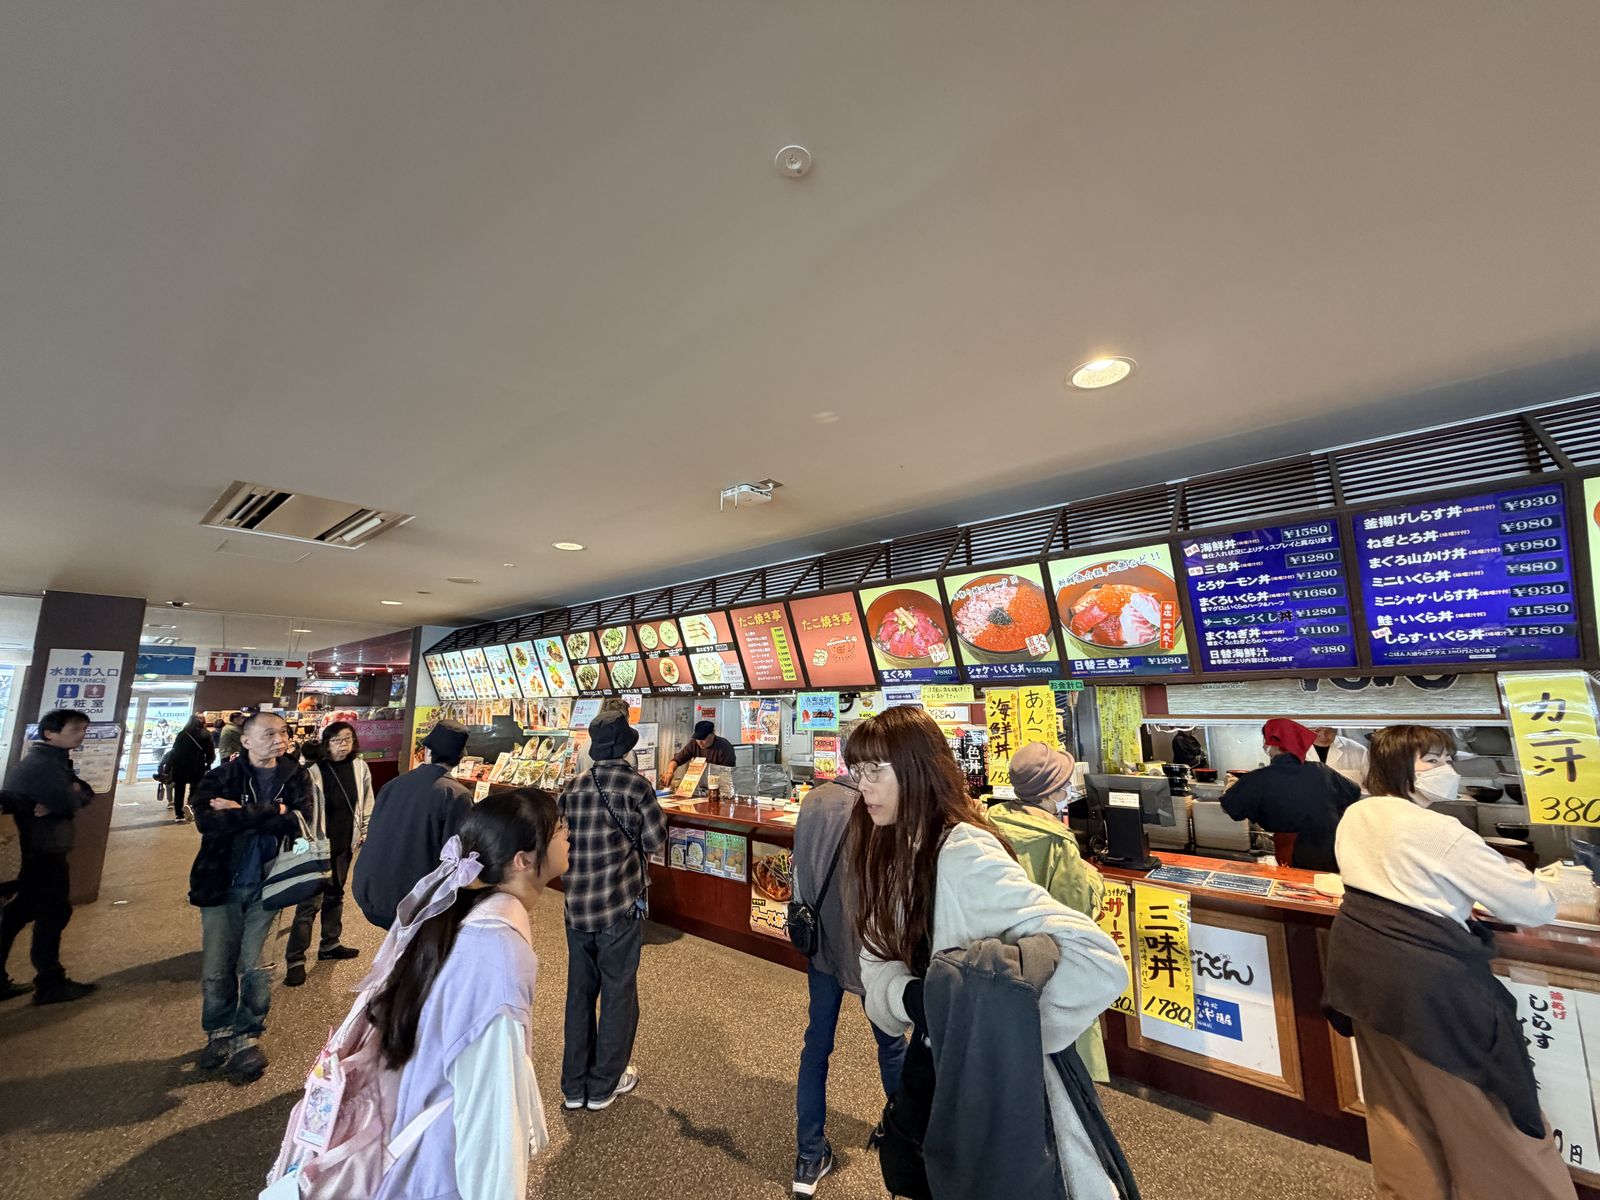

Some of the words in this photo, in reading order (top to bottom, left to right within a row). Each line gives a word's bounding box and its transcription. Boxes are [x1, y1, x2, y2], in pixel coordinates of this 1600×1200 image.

[1364, 505, 1463, 529] 釜揚げしらす丼
[1505, 495, 1557, 510] ¥930
[1200, 540, 1236, 552] 海鮮丼
[1284, 525, 1328, 540] ¥1580
[1367, 531, 1438, 549] ねぎとろ丼
[1502, 518, 1553, 533] ¥980
[1369, 548, 1467, 569] まぐろ山かけ丼
[1505, 538, 1557, 552] ¥980
[1204, 561, 1240, 574] 三色丼
[1290, 553, 1334, 566] ¥1280
[1197, 574, 1270, 592] とろサーモン丼
[1296, 569, 1338, 580] ¥1200
[1372, 571, 1451, 587] ミニいくら丼
[1507, 561, 1557, 574] ¥880
[1199, 591, 1268, 607] まぐろいくら丼
[1292, 588, 1337, 599] ¥1680
[1375, 588, 1479, 606] ミニシャケ・しらす丼
[1512, 584, 1564, 597] ¥930
[738, 610, 782, 628] たこ焼き亭
[1297, 606, 1336, 617] ¥1280
[1377, 611, 1454, 626] 鮭・いくら丼
[1510, 604, 1569, 616] ¥1580
[801, 612, 853, 631] たこ焼き亭
[1205, 628, 1261, 642] まぐねぎ丼
[1299, 625, 1339, 636] ¥1100
[1385, 629, 1485, 645] しらす・いくら丼
[1508, 626, 1564, 637] ¥1580
[1311, 645, 1345, 655] ¥380
[251, 657, 283, 666] 化粧室
[968, 664, 1026, 675] シャケ・いくら丼
[1027, 666, 1053, 674] ¥1580
[1074, 658, 1131, 670] 日替三色丼
[50, 667, 118, 678] 水族館入口
[882, 670, 912, 679] まぐろ丼
[1050, 681, 1082, 689] お会計口
[54, 699, 104, 708] 化粧室
[989, 698, 1013, 760] 海鮮丼
[1529, 692, 1587, 782] カニ汁
[1144, 905, 1185, 988] 三味丼
[1529, 993, 1555, 1050] しらす
